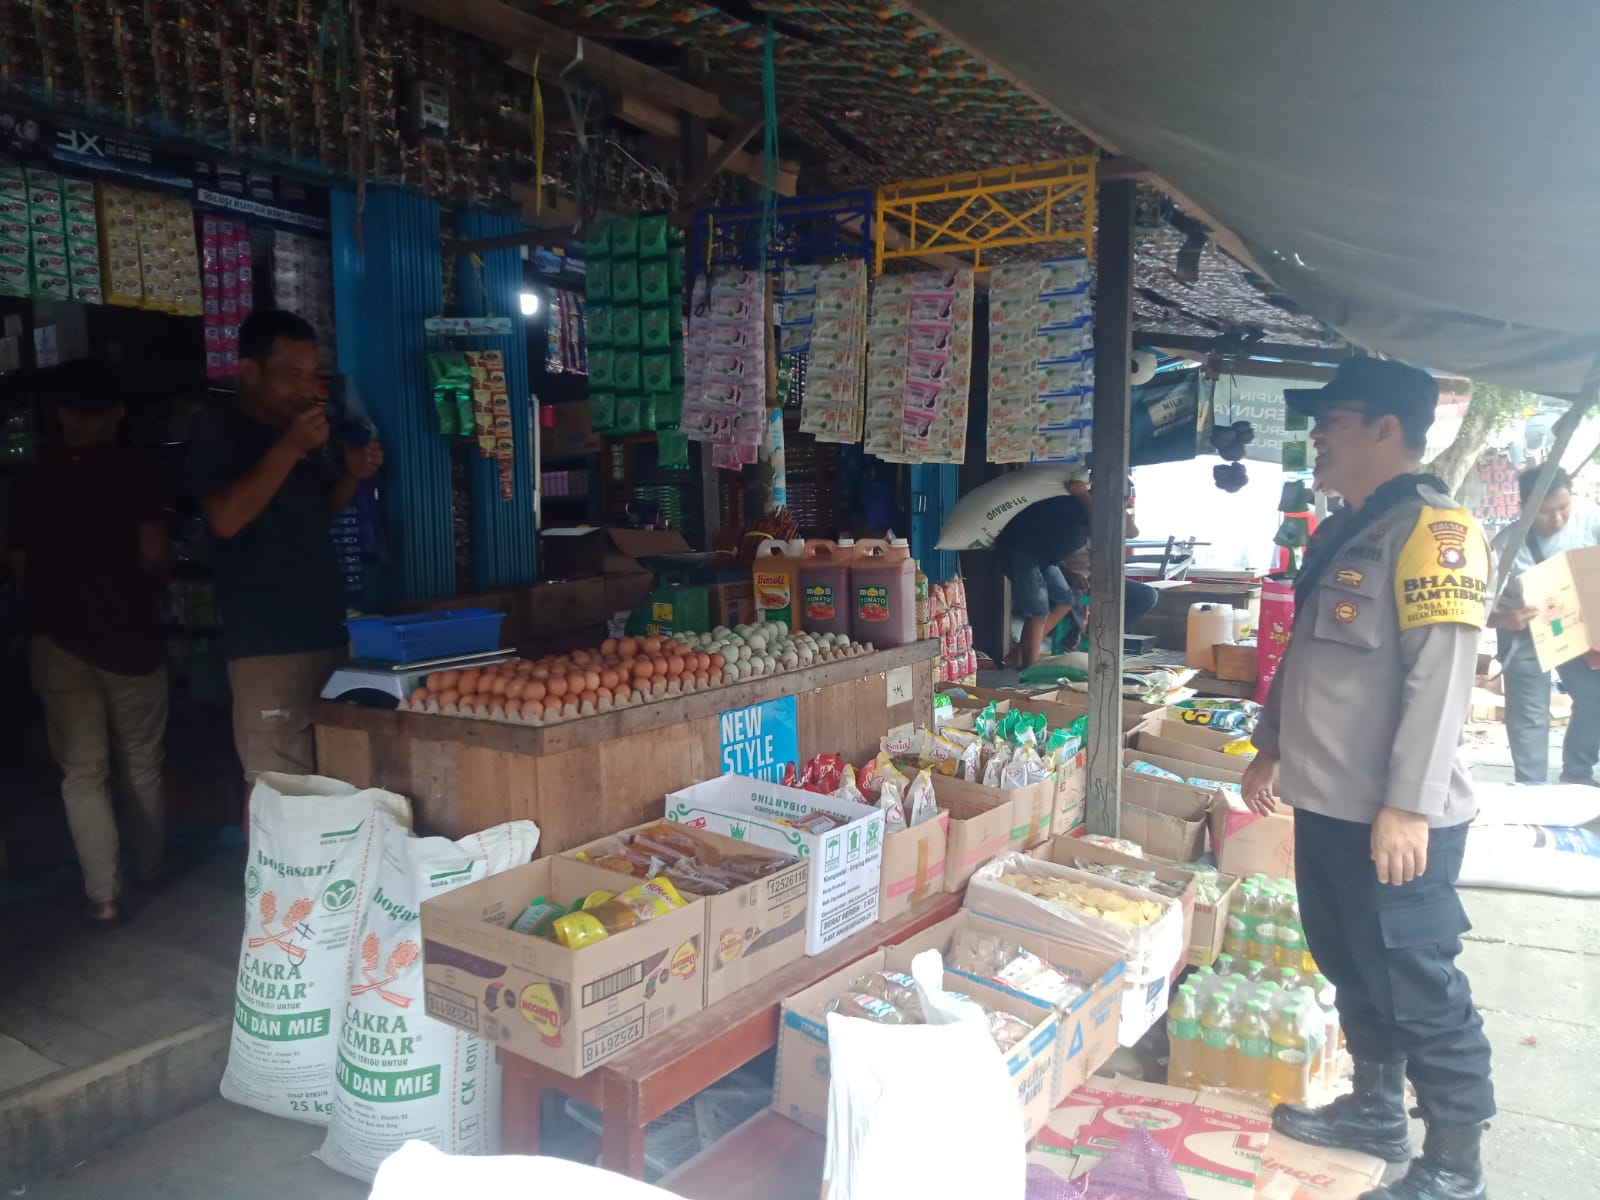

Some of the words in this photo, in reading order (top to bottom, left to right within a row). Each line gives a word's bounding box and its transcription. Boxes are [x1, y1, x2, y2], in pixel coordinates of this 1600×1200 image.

[986, 496, 1027, 520] 511-BRAVO
[1417, 601, 1442, 611] DESA
[722, 706, 762, 745] NEW
[723, 734, 775, 776] STYLE
[751, 792, 806, 813] DIBANTING
[258, 850, 335, 878] bogasari
[770, 869, 808, 894] 12526118
[244, 952, 302, 981] CAKRA
[240, 969, 307, 1001] KEMBAR
[251, 1017, 281, 1037] DAN
[287, 1015, 324, 1037] MIE
[346, 1001, 408, 1034] CAKRA
[341, 1021, 415, 1057] KEMBAR
[585, 1024, 640, 1062] 12526118
[465, 1042, 478, 1074] ROTI
[352, 1072, 387, 1098] DAN
[394, 1072, 433, 1097] MIE
[461, 1078, 477, 1106] CK
[290, 1101, 309, 1114] 25
[314, 1100, 334, 1116] kg
